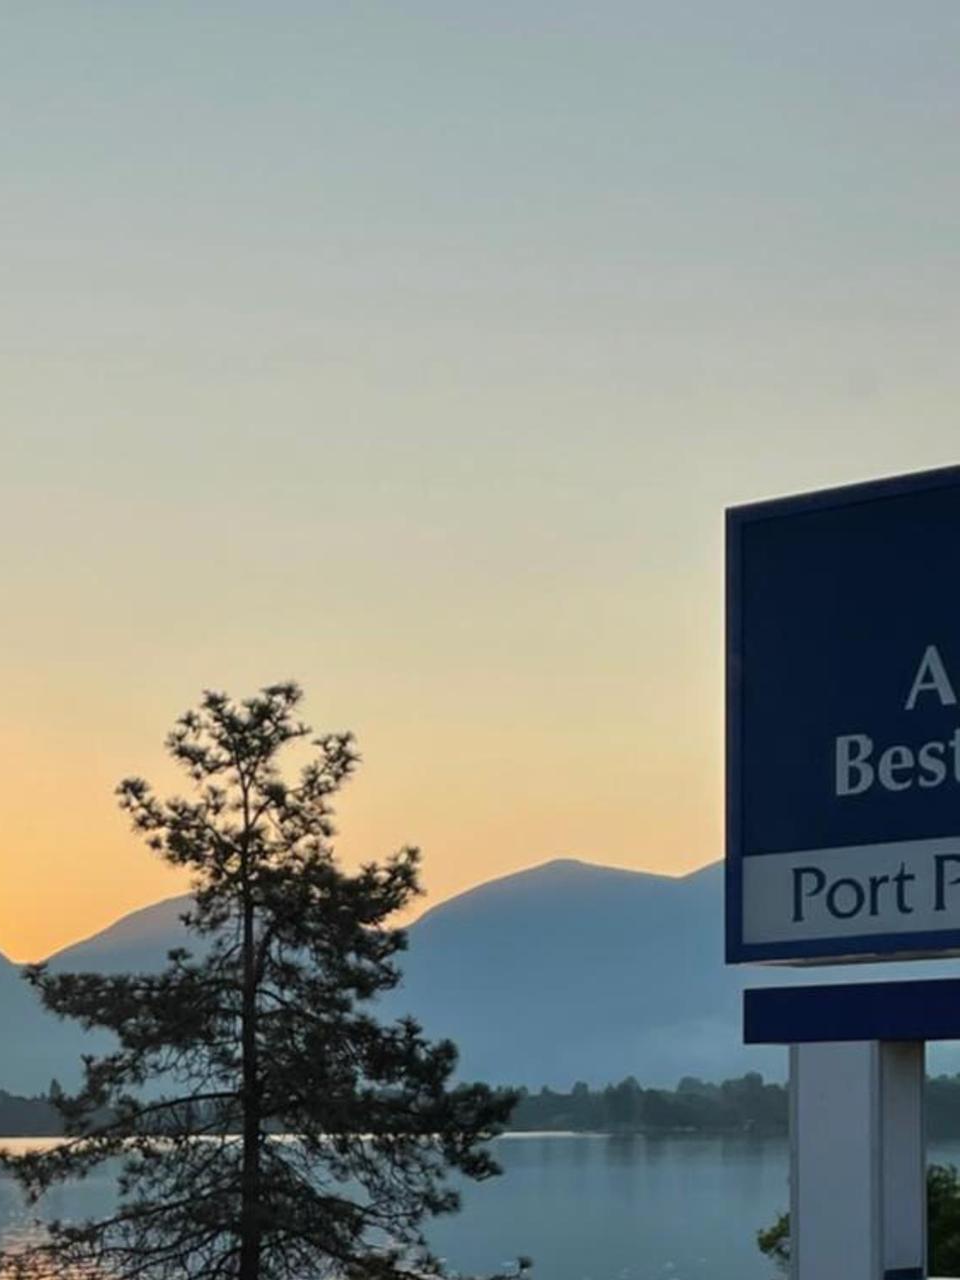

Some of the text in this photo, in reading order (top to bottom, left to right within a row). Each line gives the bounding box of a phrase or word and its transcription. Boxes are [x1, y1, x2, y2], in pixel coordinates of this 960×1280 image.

[904, 644, 957, 711] A
[791, 853, 960, 923] Port P
